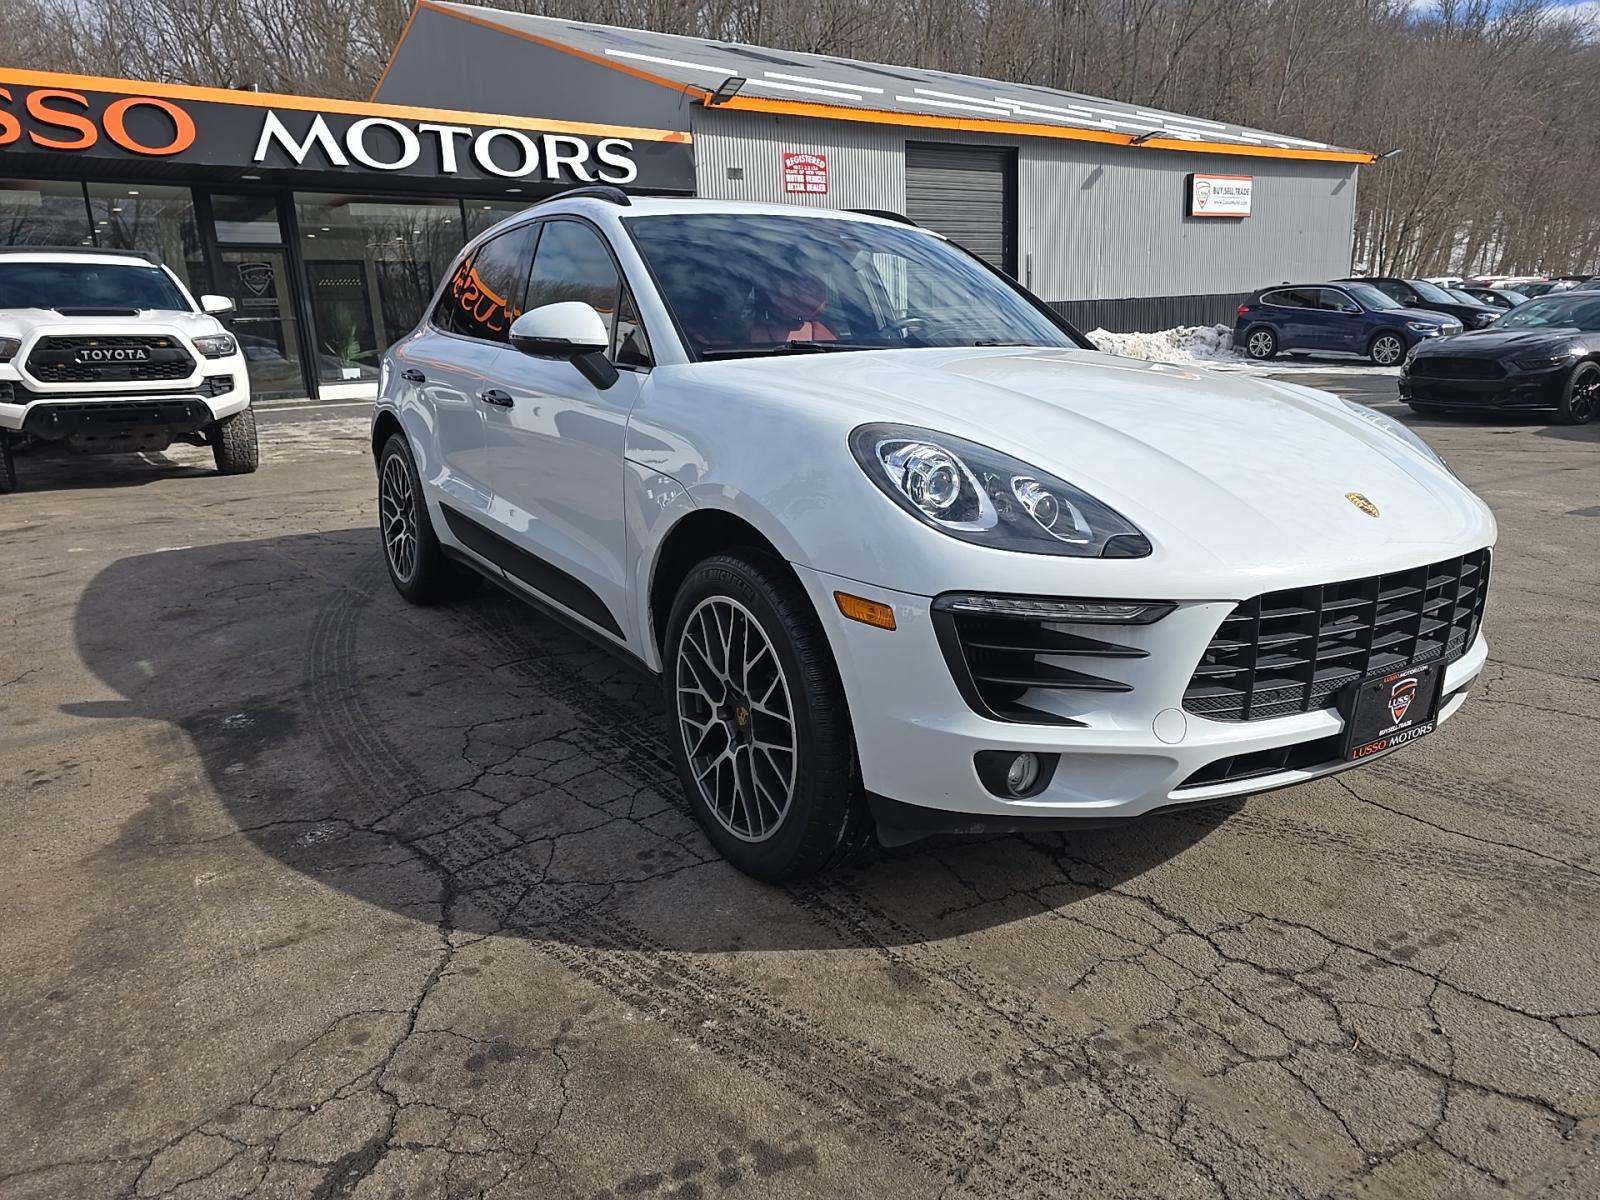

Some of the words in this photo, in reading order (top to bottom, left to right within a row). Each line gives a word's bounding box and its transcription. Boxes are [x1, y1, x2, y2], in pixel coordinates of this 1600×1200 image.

[254, 109, 638, 183] MOTORS
[785, 154, 825, 169] REGISTERED
[81, 349, 147, 360] TOYOTA
[1352, 739, 1387, 759] LUSSO
[1388, 723, 1433, 747] MOTORS
